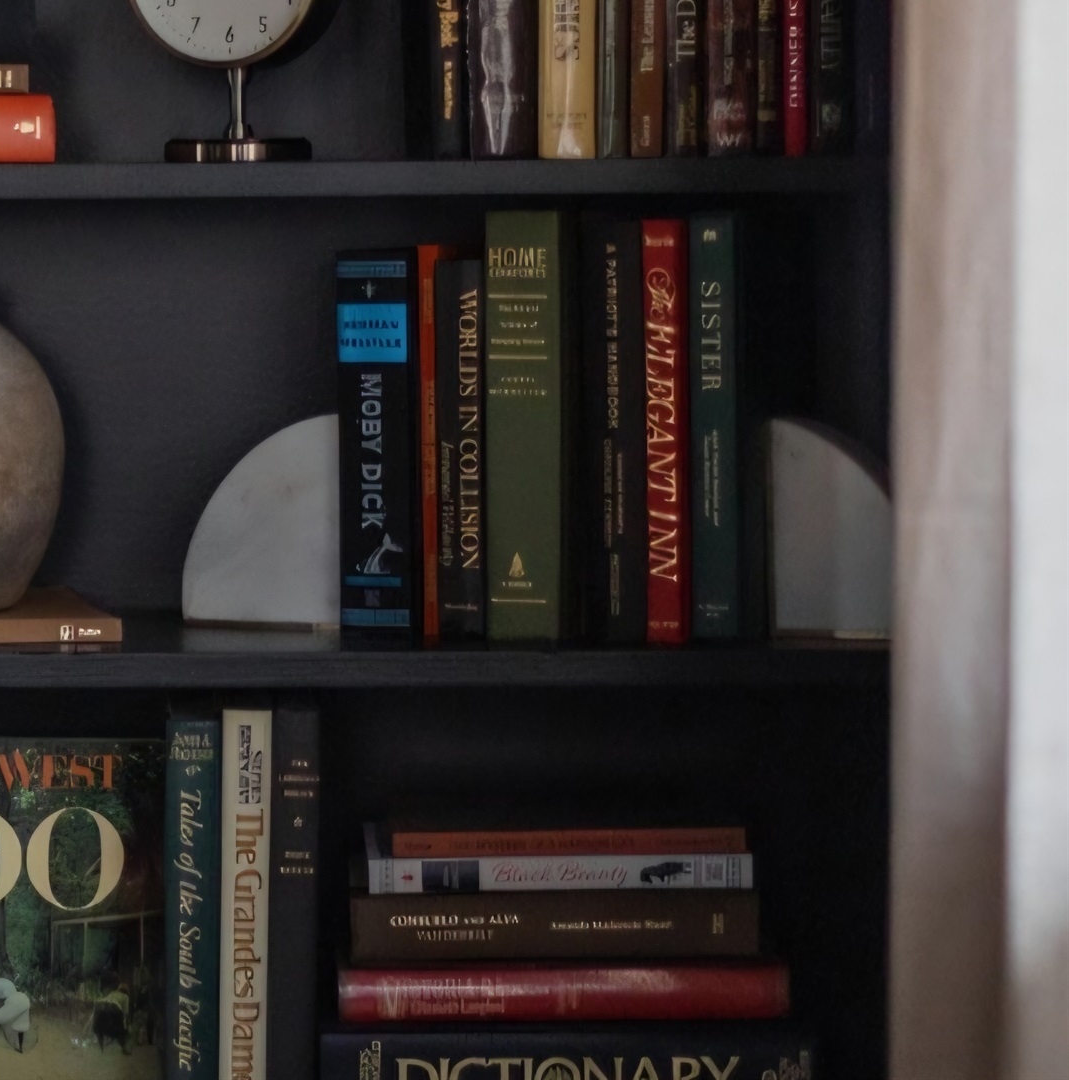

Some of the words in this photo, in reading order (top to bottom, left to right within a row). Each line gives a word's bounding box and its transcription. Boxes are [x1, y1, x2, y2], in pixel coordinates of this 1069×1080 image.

[191, 16, 201, 33] 7
[225, 24, 234, 43] 6
[259, 16, 268, 33] 5
[489, 248, 547, 268] HOME
[459, 289, 478, 396] WORLDS
[701, 281, 722, 390] SISTER
[360, 373, 382, 454] MOBY
[459, 406, 478, 431] IN
[646, 322, 677, 503] ELEGANT
[361, 462, 384, 529] DICK
[458, 438, 479, 569] COLLISION
[648, 508, 677, 583] INN
[179, 789, 203, 848] Tales
[235, 808, 264, 866] The
[174, 853, 203, 879] of
[178, 921, 203, 986] South
[233, 869, 262, 1000] Grandes
[177, 995, 203, 1072] Pacific
